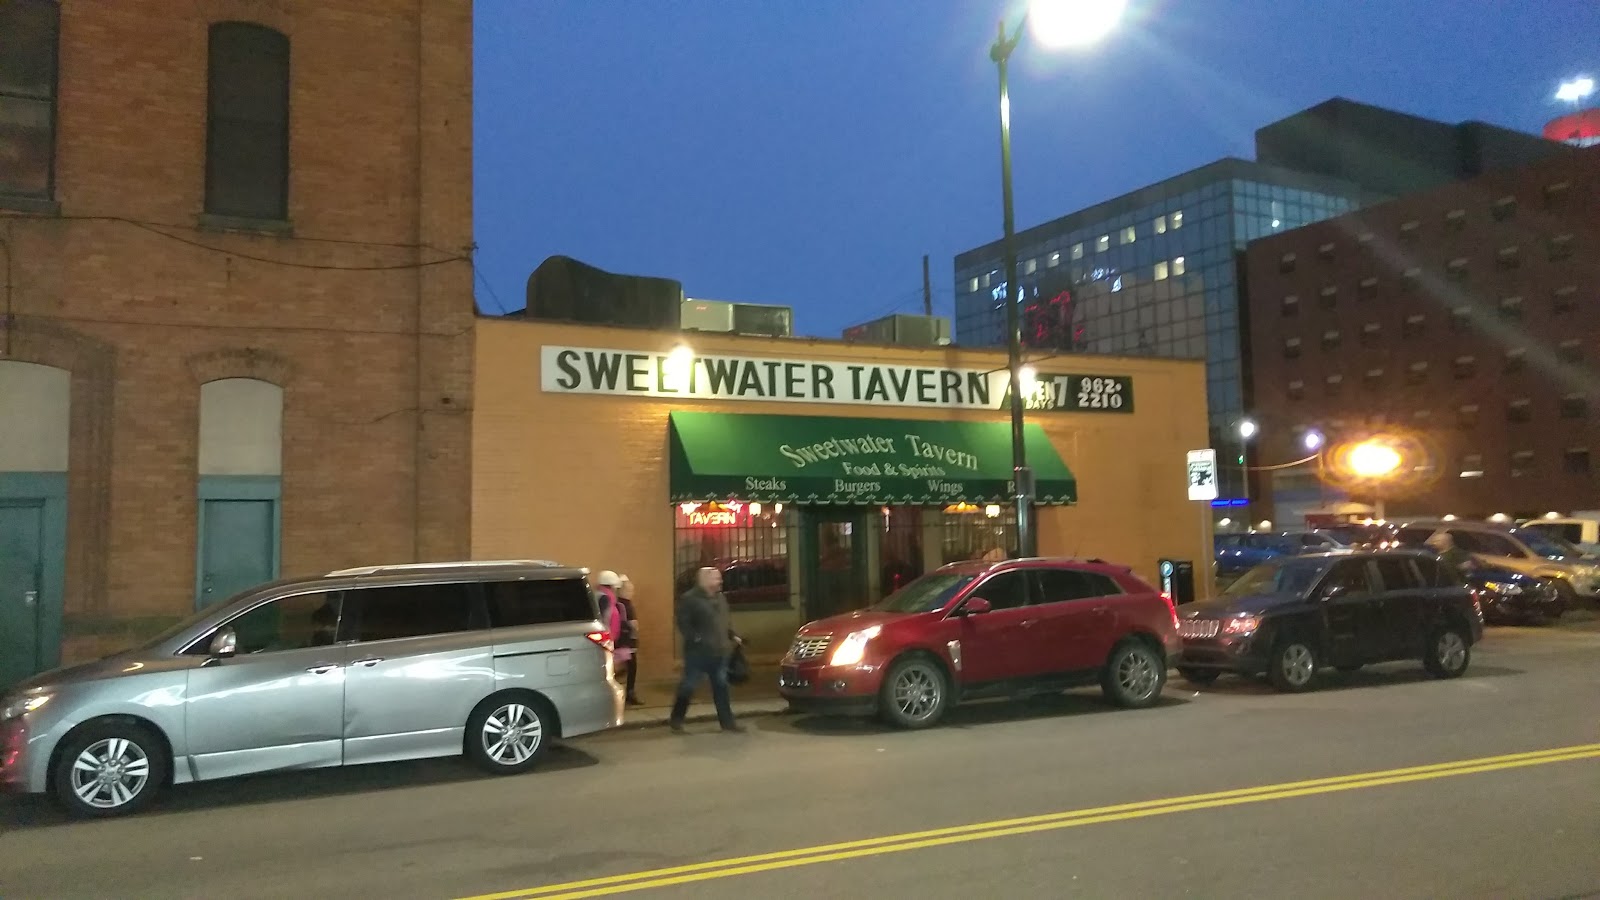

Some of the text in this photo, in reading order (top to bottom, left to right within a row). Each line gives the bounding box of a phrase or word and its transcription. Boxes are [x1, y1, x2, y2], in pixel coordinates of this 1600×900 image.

[556, 350, 990, 405] SWEETWATER TAVERN
[1054, 375, 1069, 408] 7
[1077, 392, 1123, 409] 2210
[779, 433, 978, 471] Sweetwater Tavern
[842, 461, 946, 480] Food & Spirits
[745, 476, 787, 491] Steaks
[834, 479, 881, 495] Burgers
[926, 479, 964, 496] Wings
[689, 511, 736, 526] TAVERN
